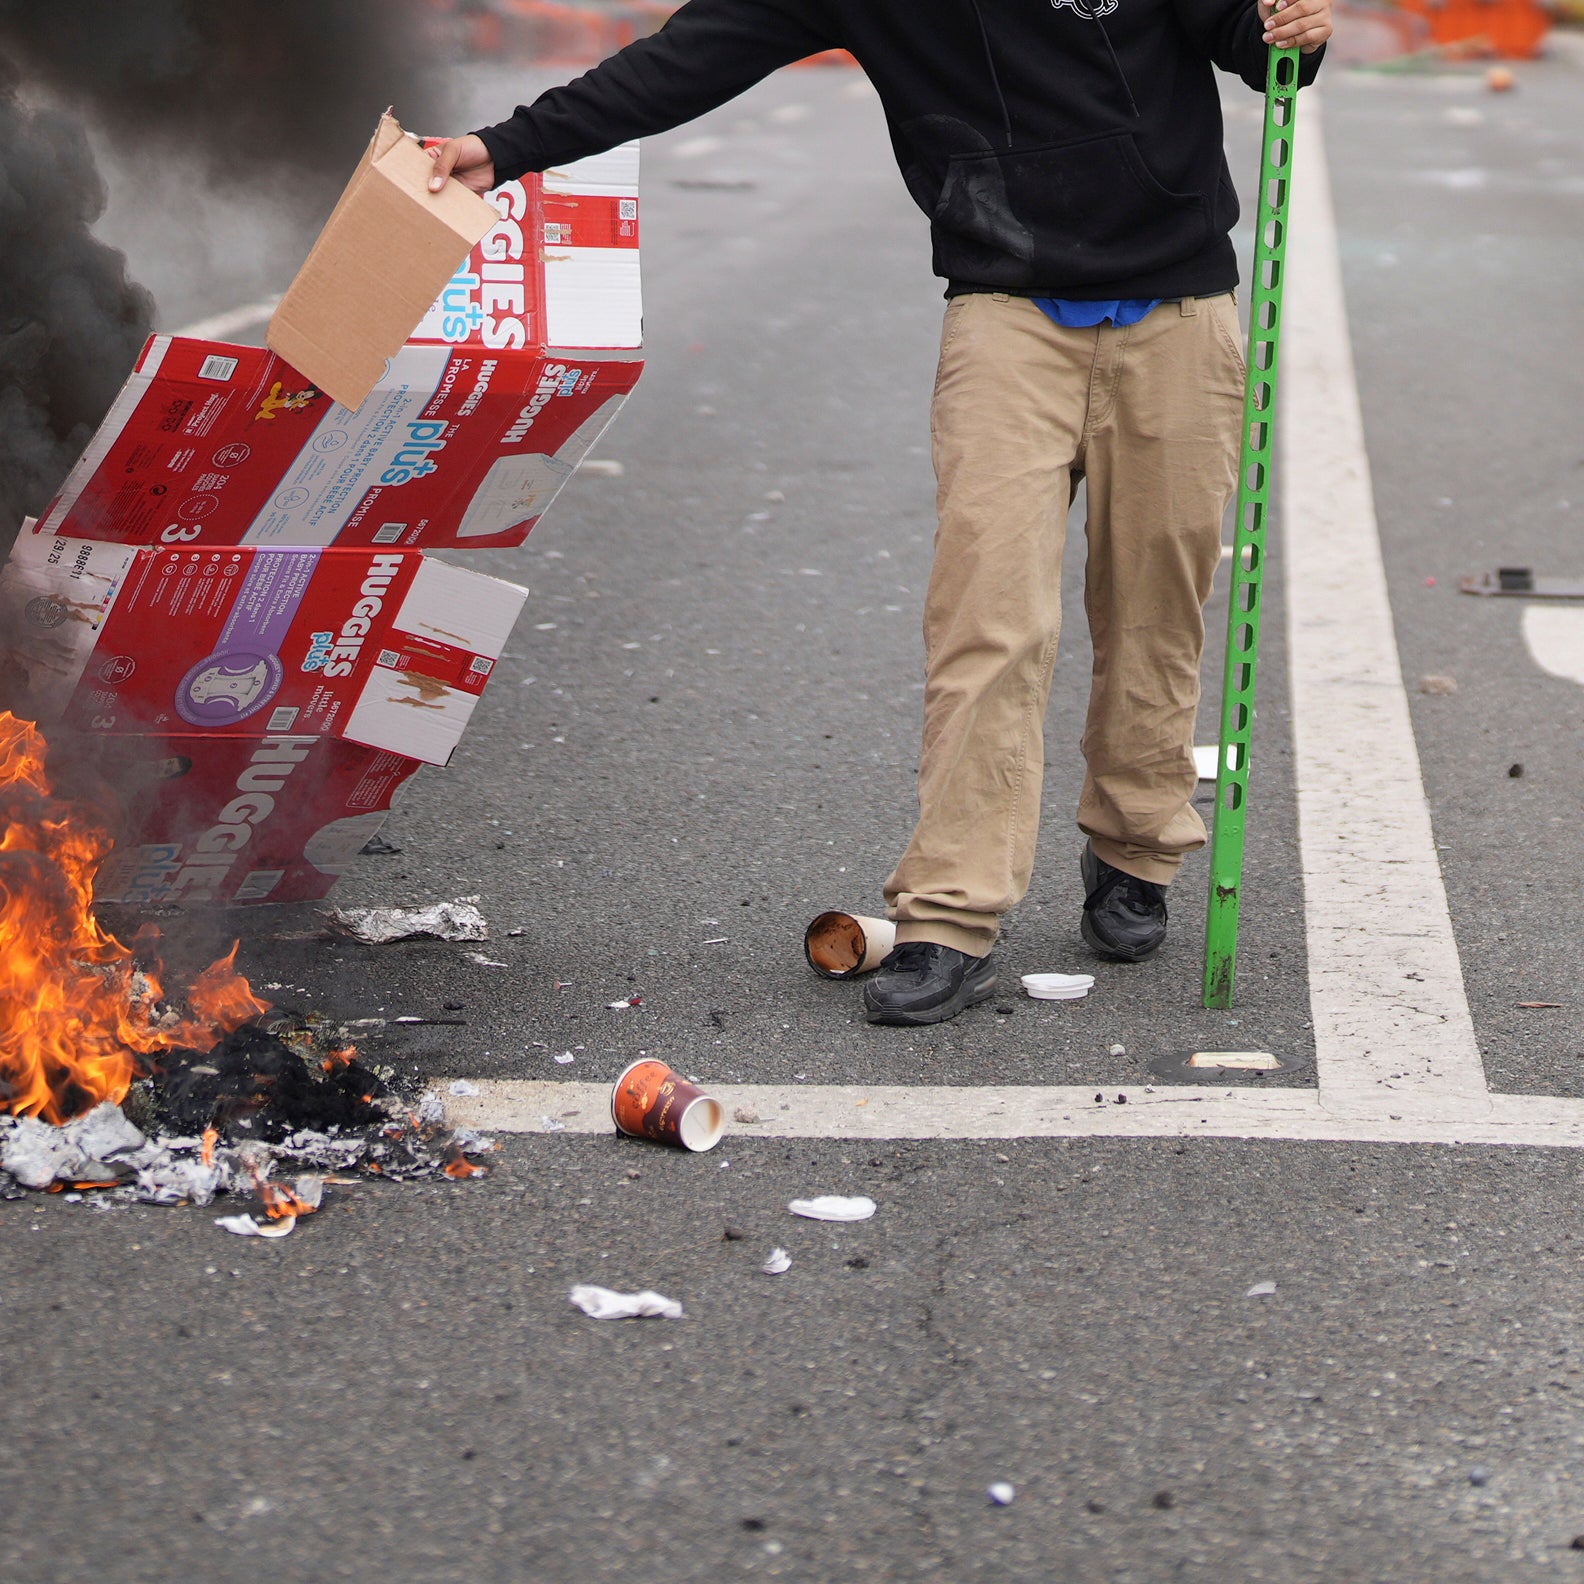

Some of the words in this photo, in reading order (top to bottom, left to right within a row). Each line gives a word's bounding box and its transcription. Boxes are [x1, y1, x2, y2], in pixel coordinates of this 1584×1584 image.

[481, 180, 527, 350] GGIES
[443, 259, 484, 338] lus
[459, 358, 472, 370] LA
[423, 358, 462, 416] PROMESSE
[455, 359, 497, 416] HUGGIES
[370, 383, 410, 432] PROTECTION
[392, 398, 413, 418] 2-in-1
[499, 363, 563, 443] HUGGIES
[372, 419, 398, 446] ACTIVE
[443, 423, 461, 438] THE
[353, 439, 373, 456] dans
[359, 447, 379, 466] BABY
[380, 422, 444, 483] plus
[212, 475, 229, 489] 204
[335, 463, 356, 484] POUR
[321, 485, 342, 504] BÉBÉ
[326, 467, 366, 514] PROTECTION
[306, 505, 328, 526] ACTIF
[346, 487, 382, 528] PROMISE
[161, 524, 202, 543] 3
[251, 553, 266, 573] Coupe
[260, 553, 275, 573] POUR
[284, 553, 299, 574] Secure
[294, 553, 308, 571] BABY
[302, 553, 316, 572] 2-in-1
[253, 573, 267, 590] BÉBÉ
[259, 553, 284, 596] PROTECTION
[280, 574, 290, 583] Fit
[271, 588, 283, 604] Extra
[275, 572, 300, 615] PROTECTION
[290, 573, 308, 598] ACTIVE
[244, 591, 258, 611] ACTIF
[250, 602, 262, 618] dans
[257, 605, 277, 634] Absorbent
[326, 554, 402, 677] HUGGIES
[302, 632, 331, 671] plus
[315, 690, 334, 713] little
[91, 715, 115, 729] 3
